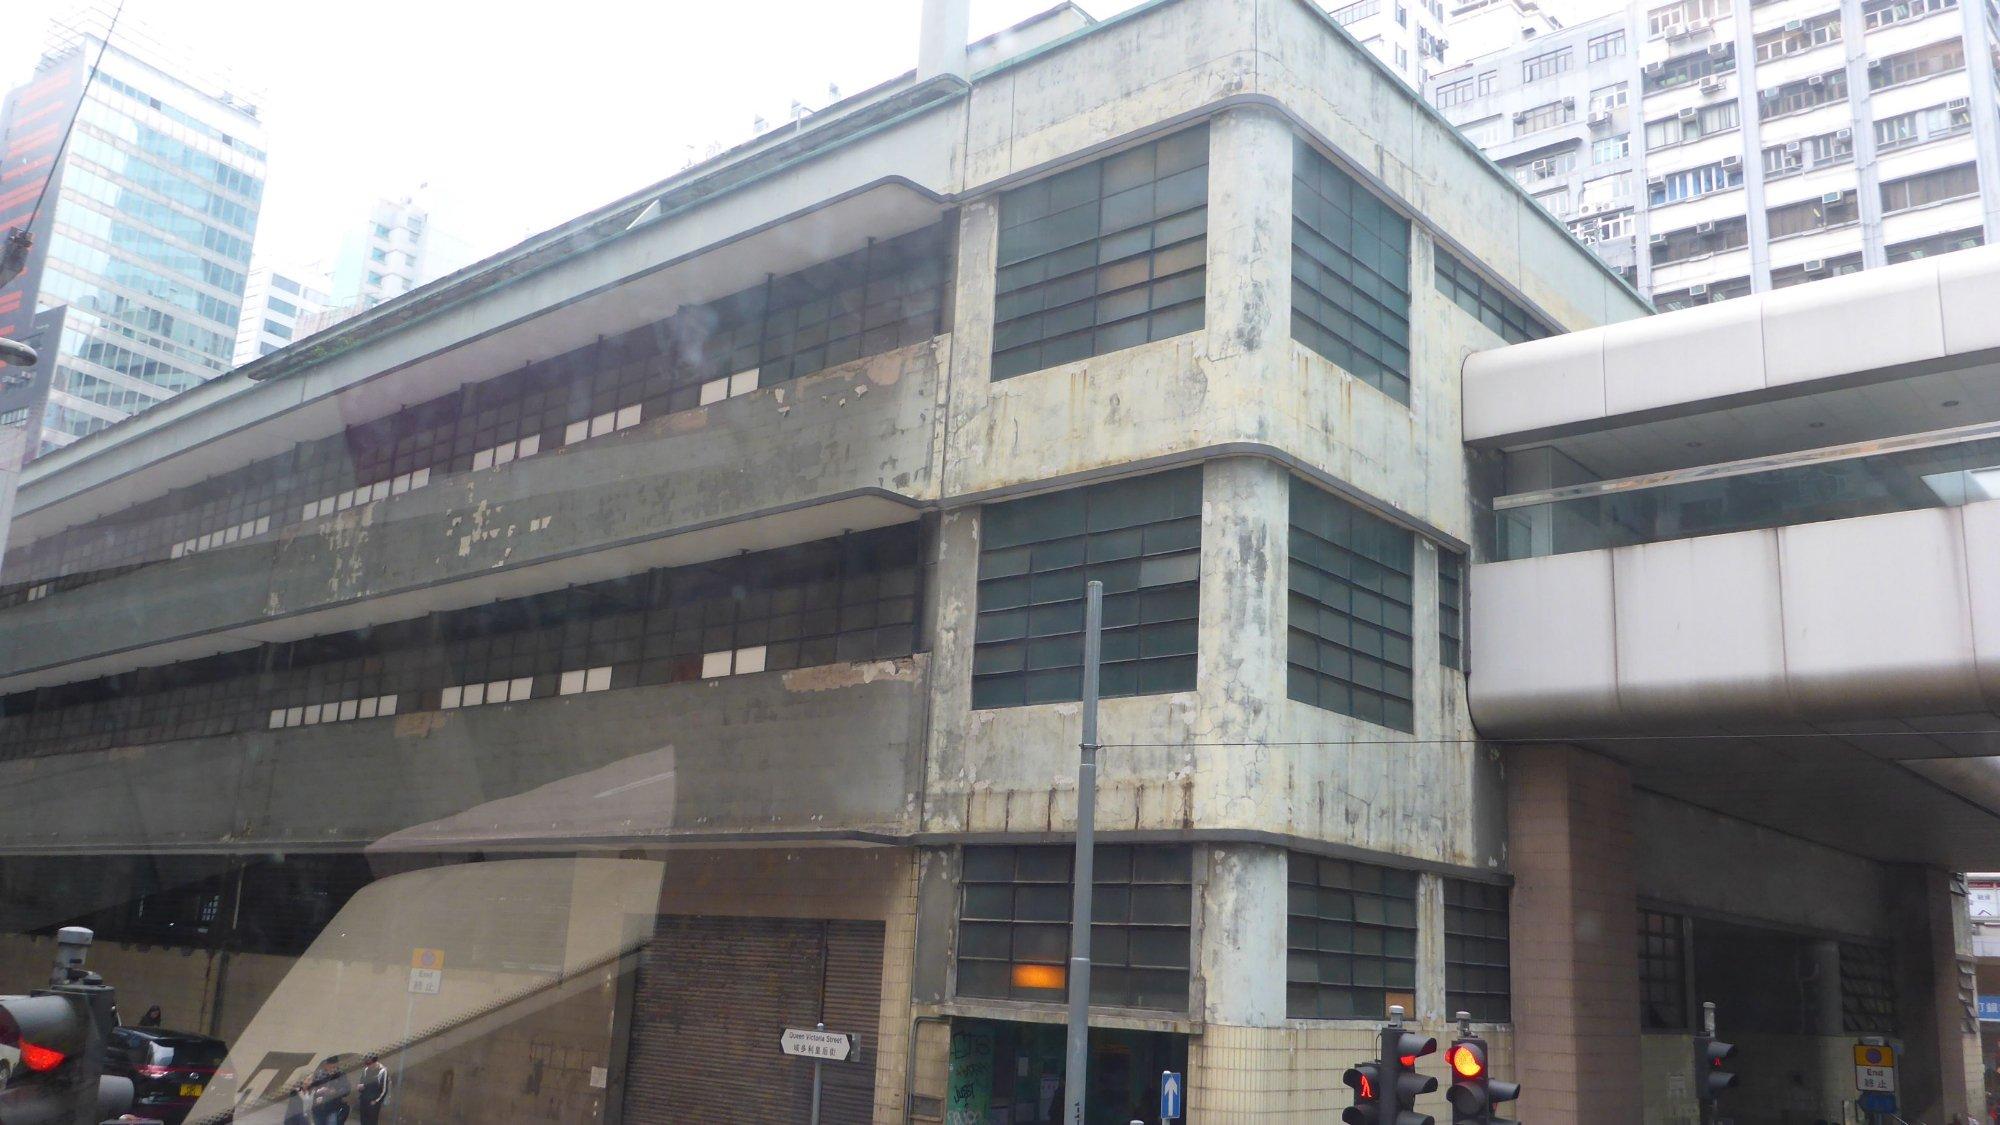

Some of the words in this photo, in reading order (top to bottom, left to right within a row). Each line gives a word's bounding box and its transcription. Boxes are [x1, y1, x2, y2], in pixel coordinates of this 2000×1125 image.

[806, 1033, 825, 1042] Victoria
[826, 1035, 843, 1044] Street
[1867, 1068, 1883, 1076] End
